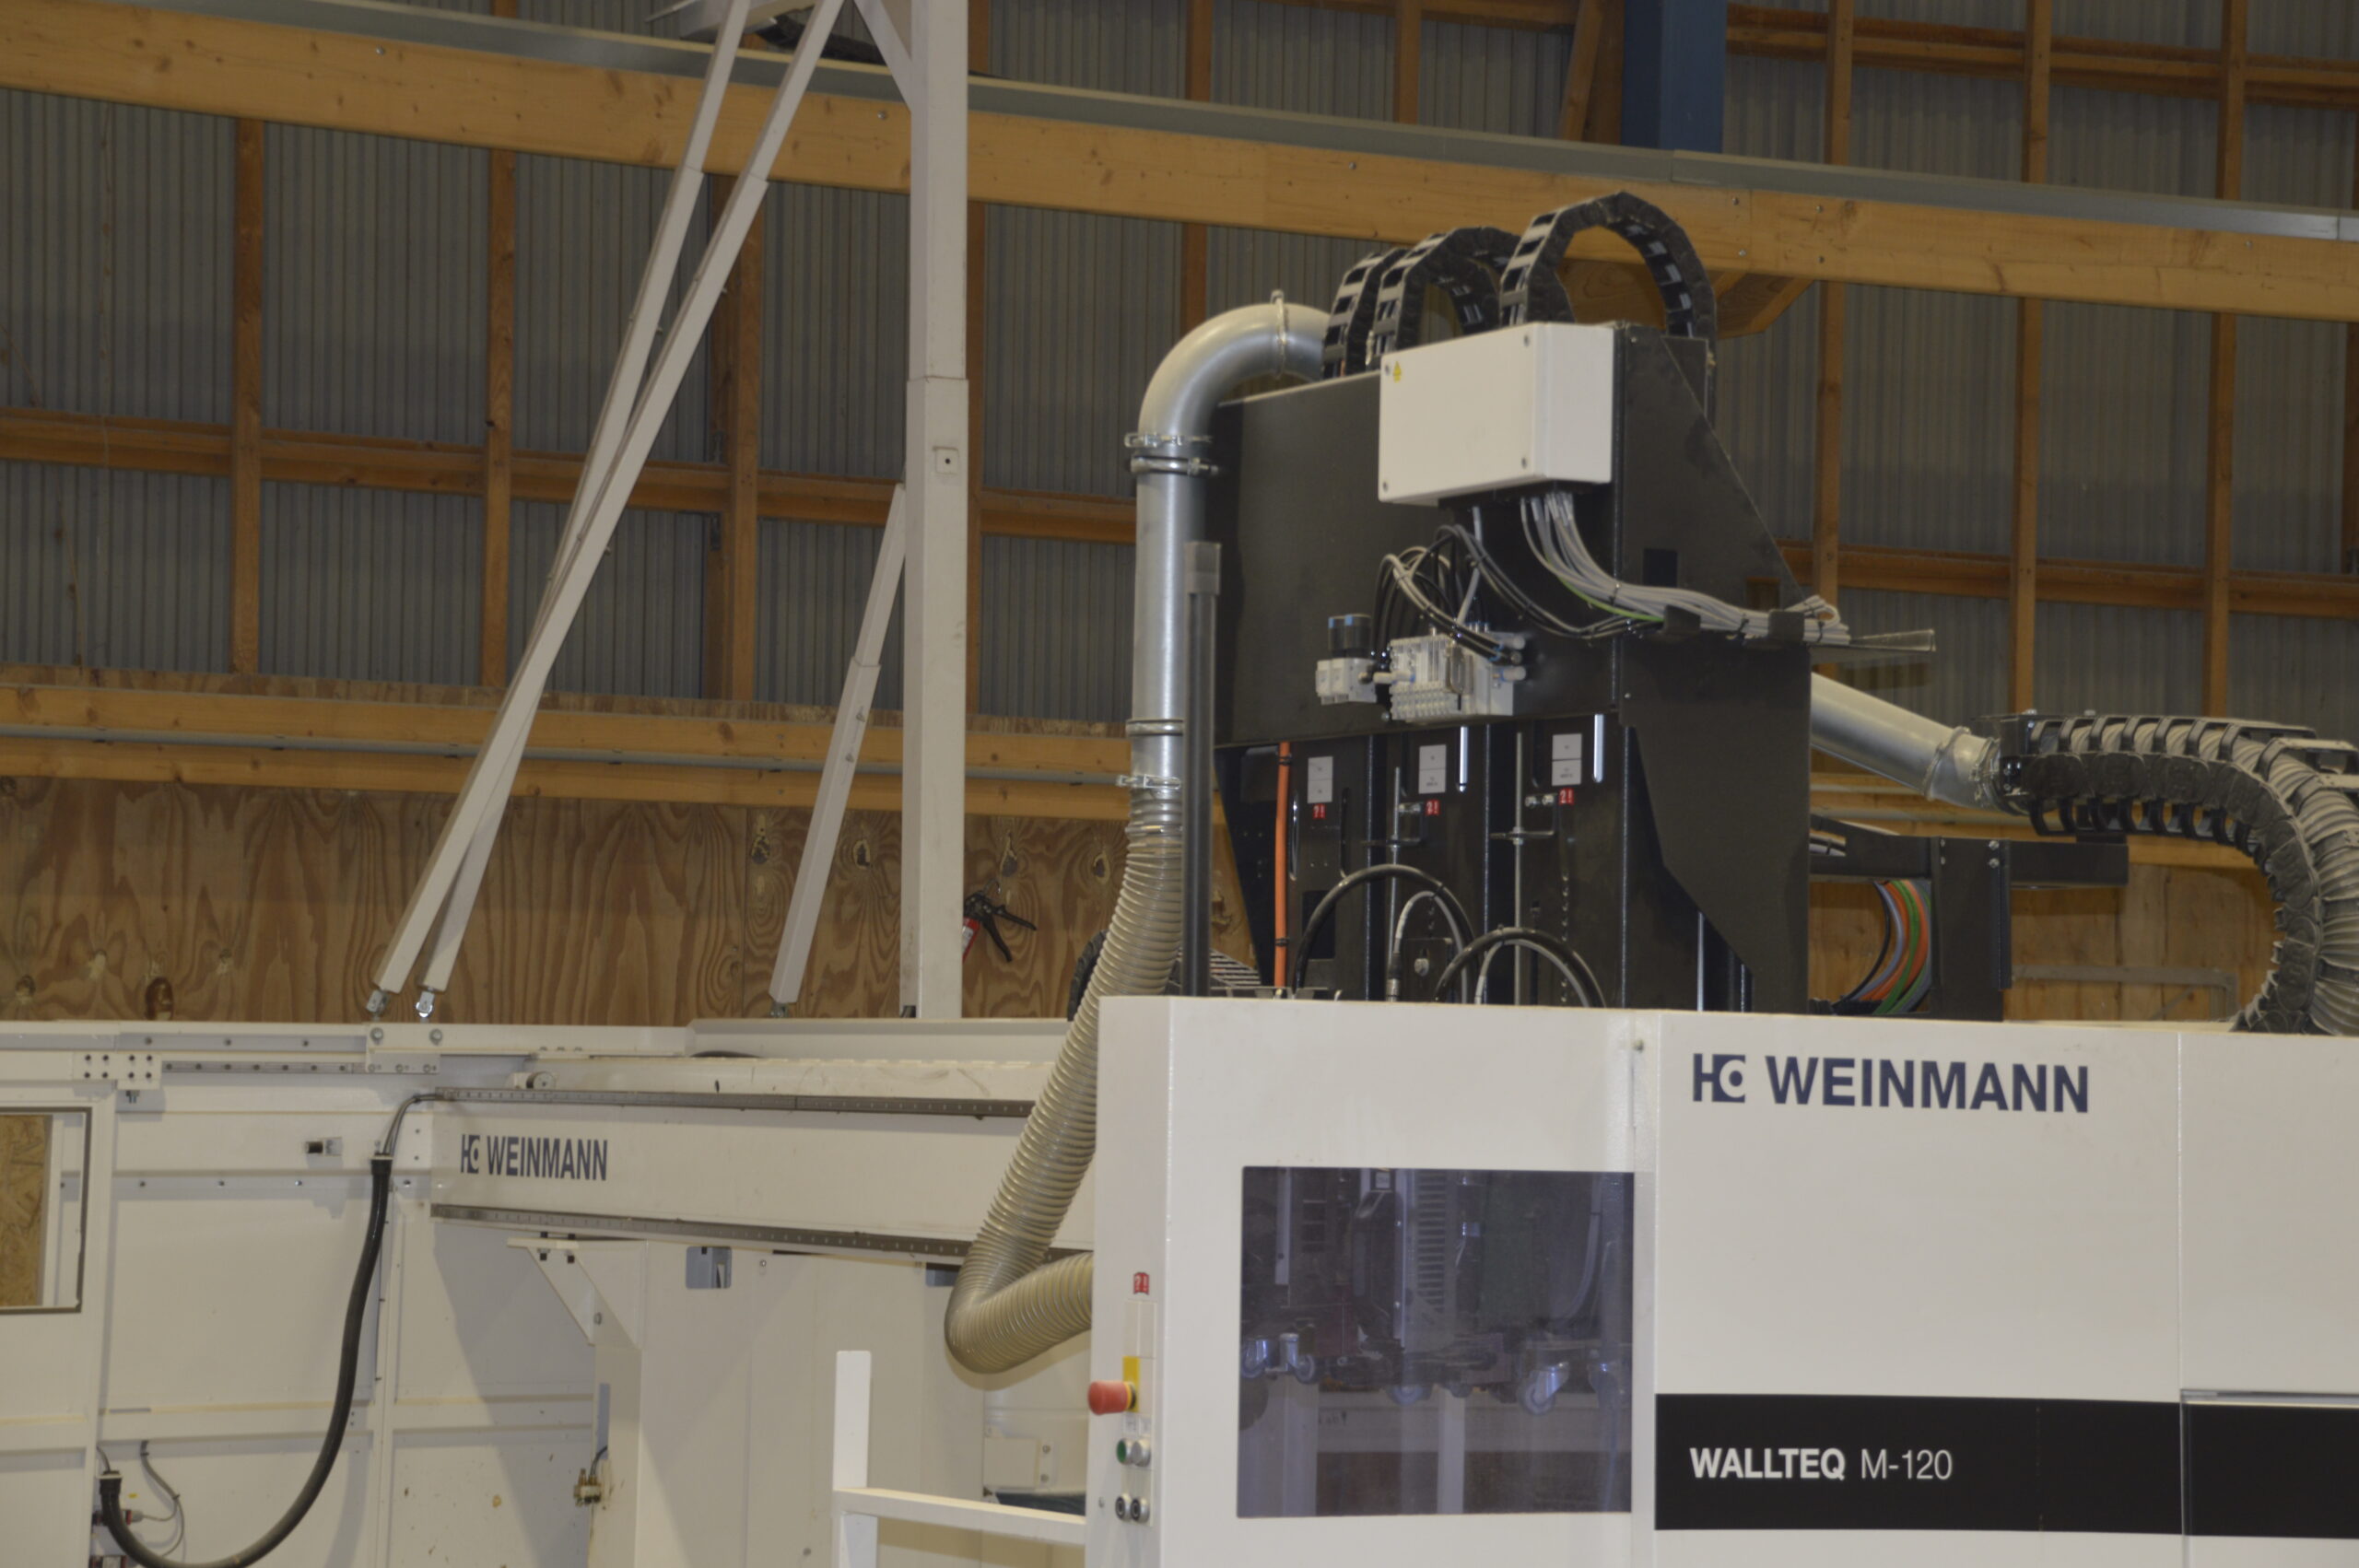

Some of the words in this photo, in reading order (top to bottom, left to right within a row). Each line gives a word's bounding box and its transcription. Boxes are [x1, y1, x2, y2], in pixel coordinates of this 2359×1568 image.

[1764, 1055, 2089, 1113] WEINMANN
[487, 1135, 608, 1181] WEINMANN
[1689, 1447, 1846, 1480] WALLTEQ
[1860, 1448, 1953, 1480] M-120
